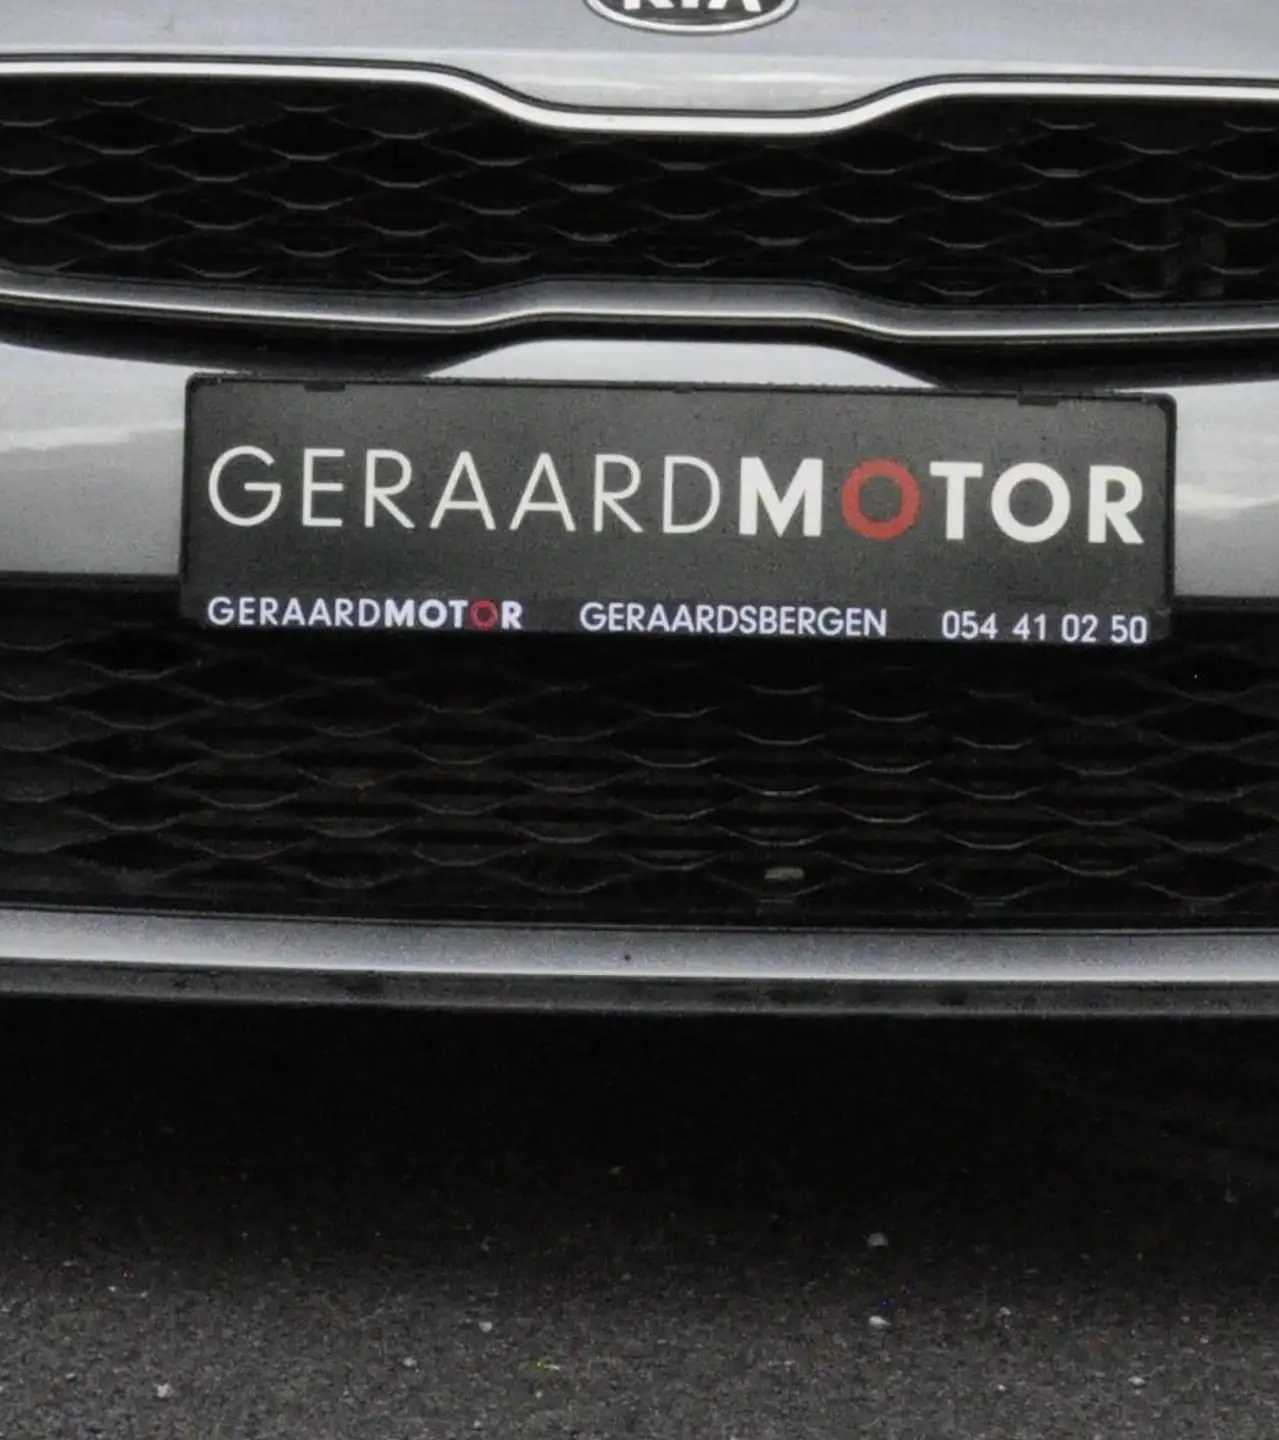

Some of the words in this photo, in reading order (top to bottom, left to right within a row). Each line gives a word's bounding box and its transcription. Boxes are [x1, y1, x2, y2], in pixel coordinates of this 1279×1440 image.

[208, 446, 1145, 545] GERAARDMOTOR
[207, 596, 523, 630] GERAARDMOTOR
[579, 601, 887, 637] GERAARDSBERGEN
[941, 610, 999, 640] 054
[1011, 613, 1046, 641] 41
[1061, 613, 1099, 643] 02
[1110, 614, 1148, 645] 50
